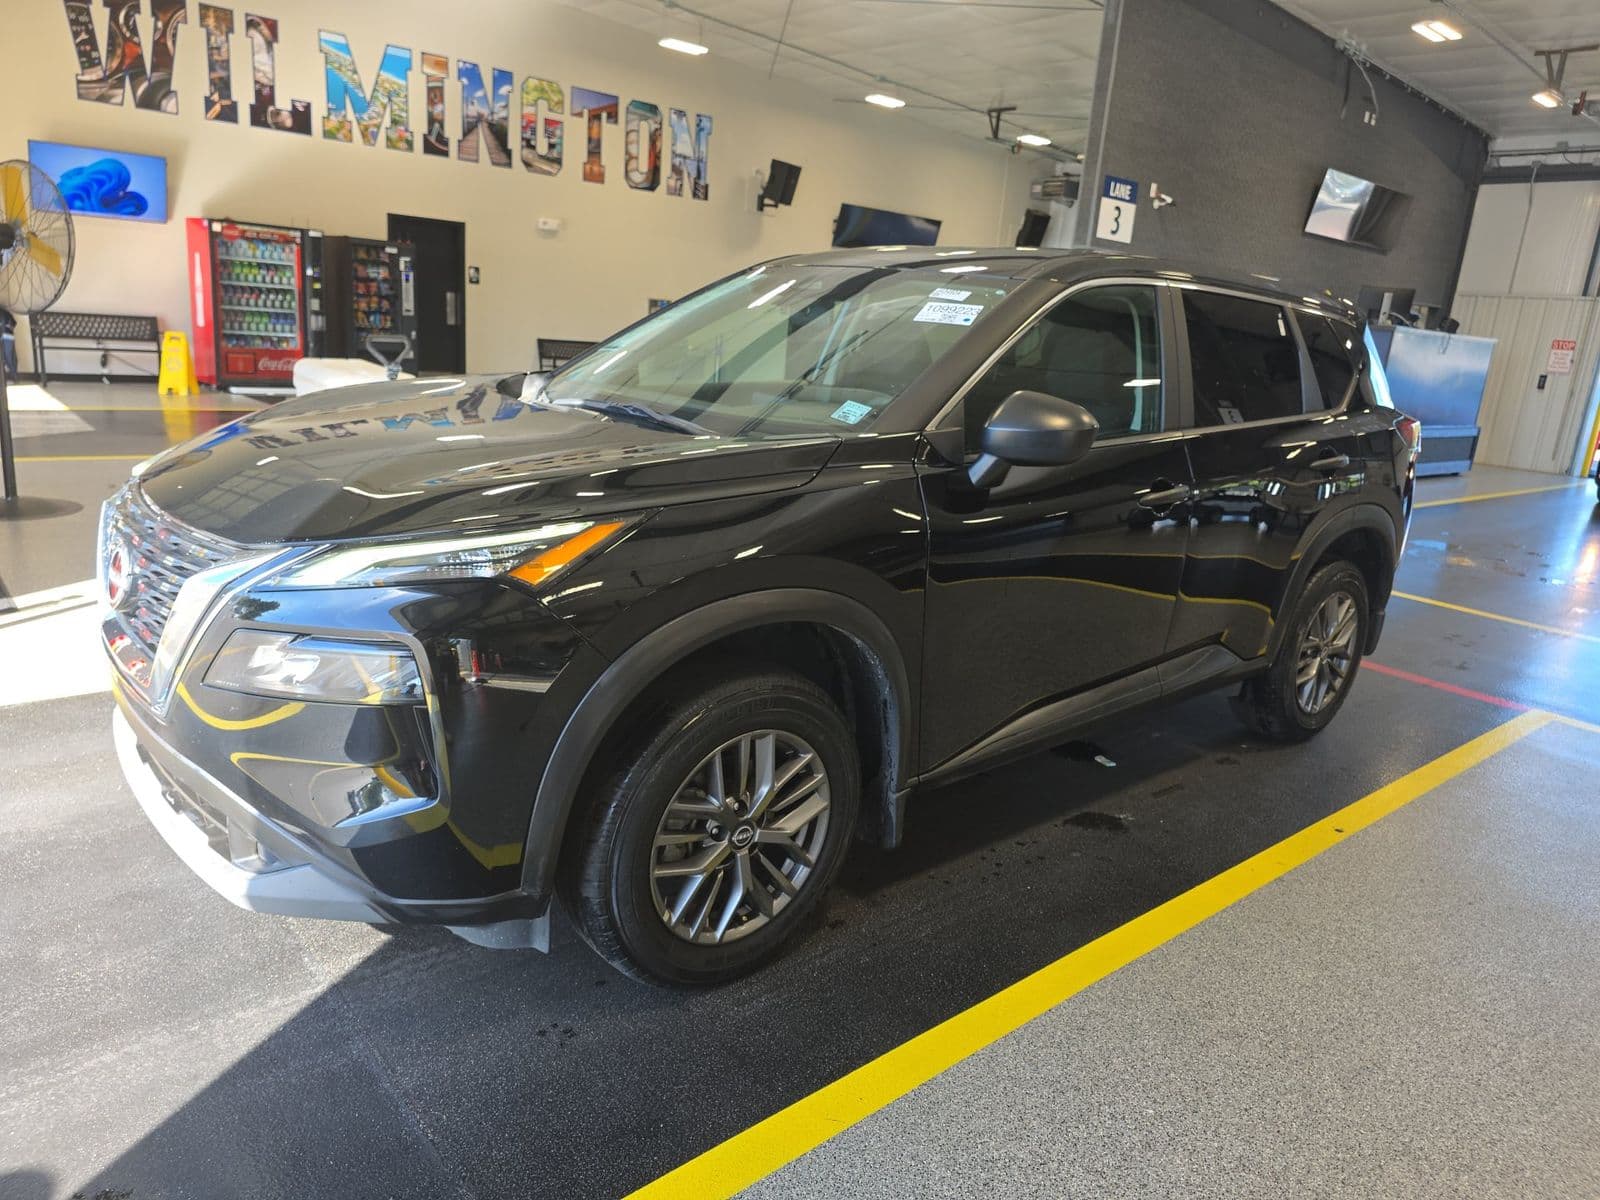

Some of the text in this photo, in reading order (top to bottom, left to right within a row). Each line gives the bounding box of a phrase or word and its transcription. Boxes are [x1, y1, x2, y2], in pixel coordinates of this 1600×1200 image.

[63, 0, 713, 201] WILMINGTON
[1109, 181, 1132, 200] LANE
[1110, 206, 1121, 234] 3
[1552, 341, 1576, 350] STOP
